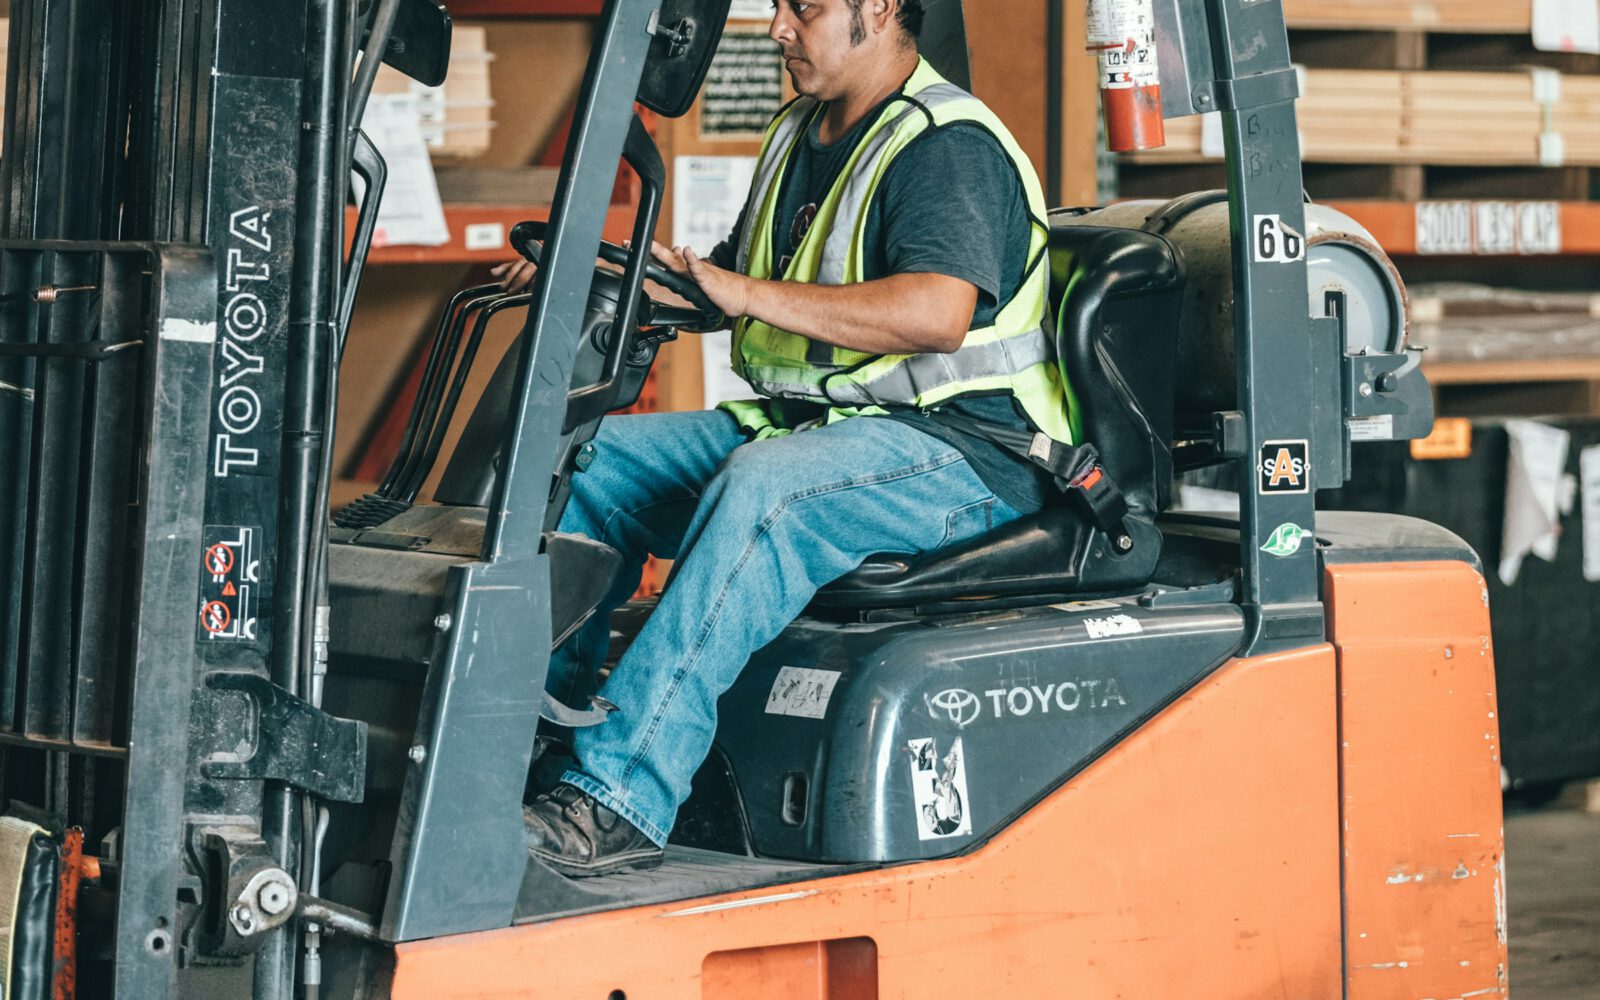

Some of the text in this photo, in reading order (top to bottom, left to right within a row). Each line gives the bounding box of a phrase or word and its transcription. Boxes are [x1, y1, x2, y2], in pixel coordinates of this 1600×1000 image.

[214, 205, 272, 477] TOYOTA
[1263, 448, 1304, 486] SAS
[985, 678, 1127, 718] TOYOTA
